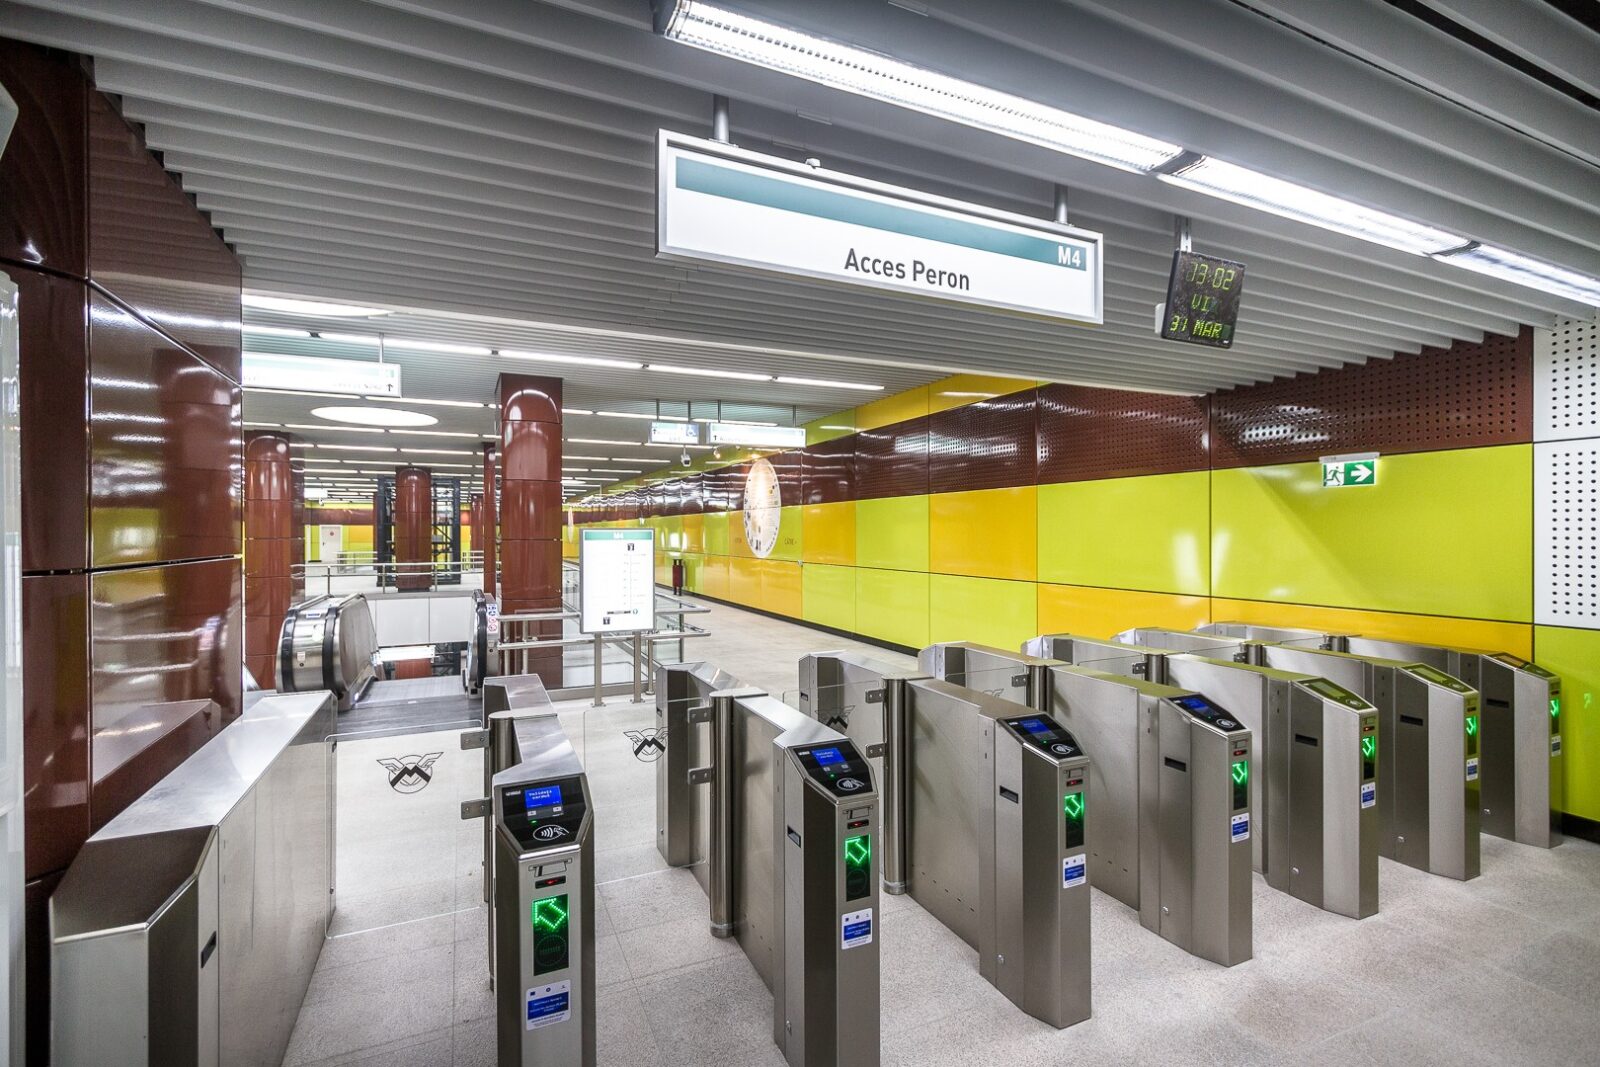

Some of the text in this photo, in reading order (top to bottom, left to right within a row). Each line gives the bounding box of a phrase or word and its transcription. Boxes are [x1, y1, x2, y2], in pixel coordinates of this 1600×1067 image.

[1058, 245, 1081, 267] M4
[844, 248, 970, 291] Acces Peron
[1188, 261, 1236, 290] 13:02
[1170, 315, 1223, 338] 31 MAR
